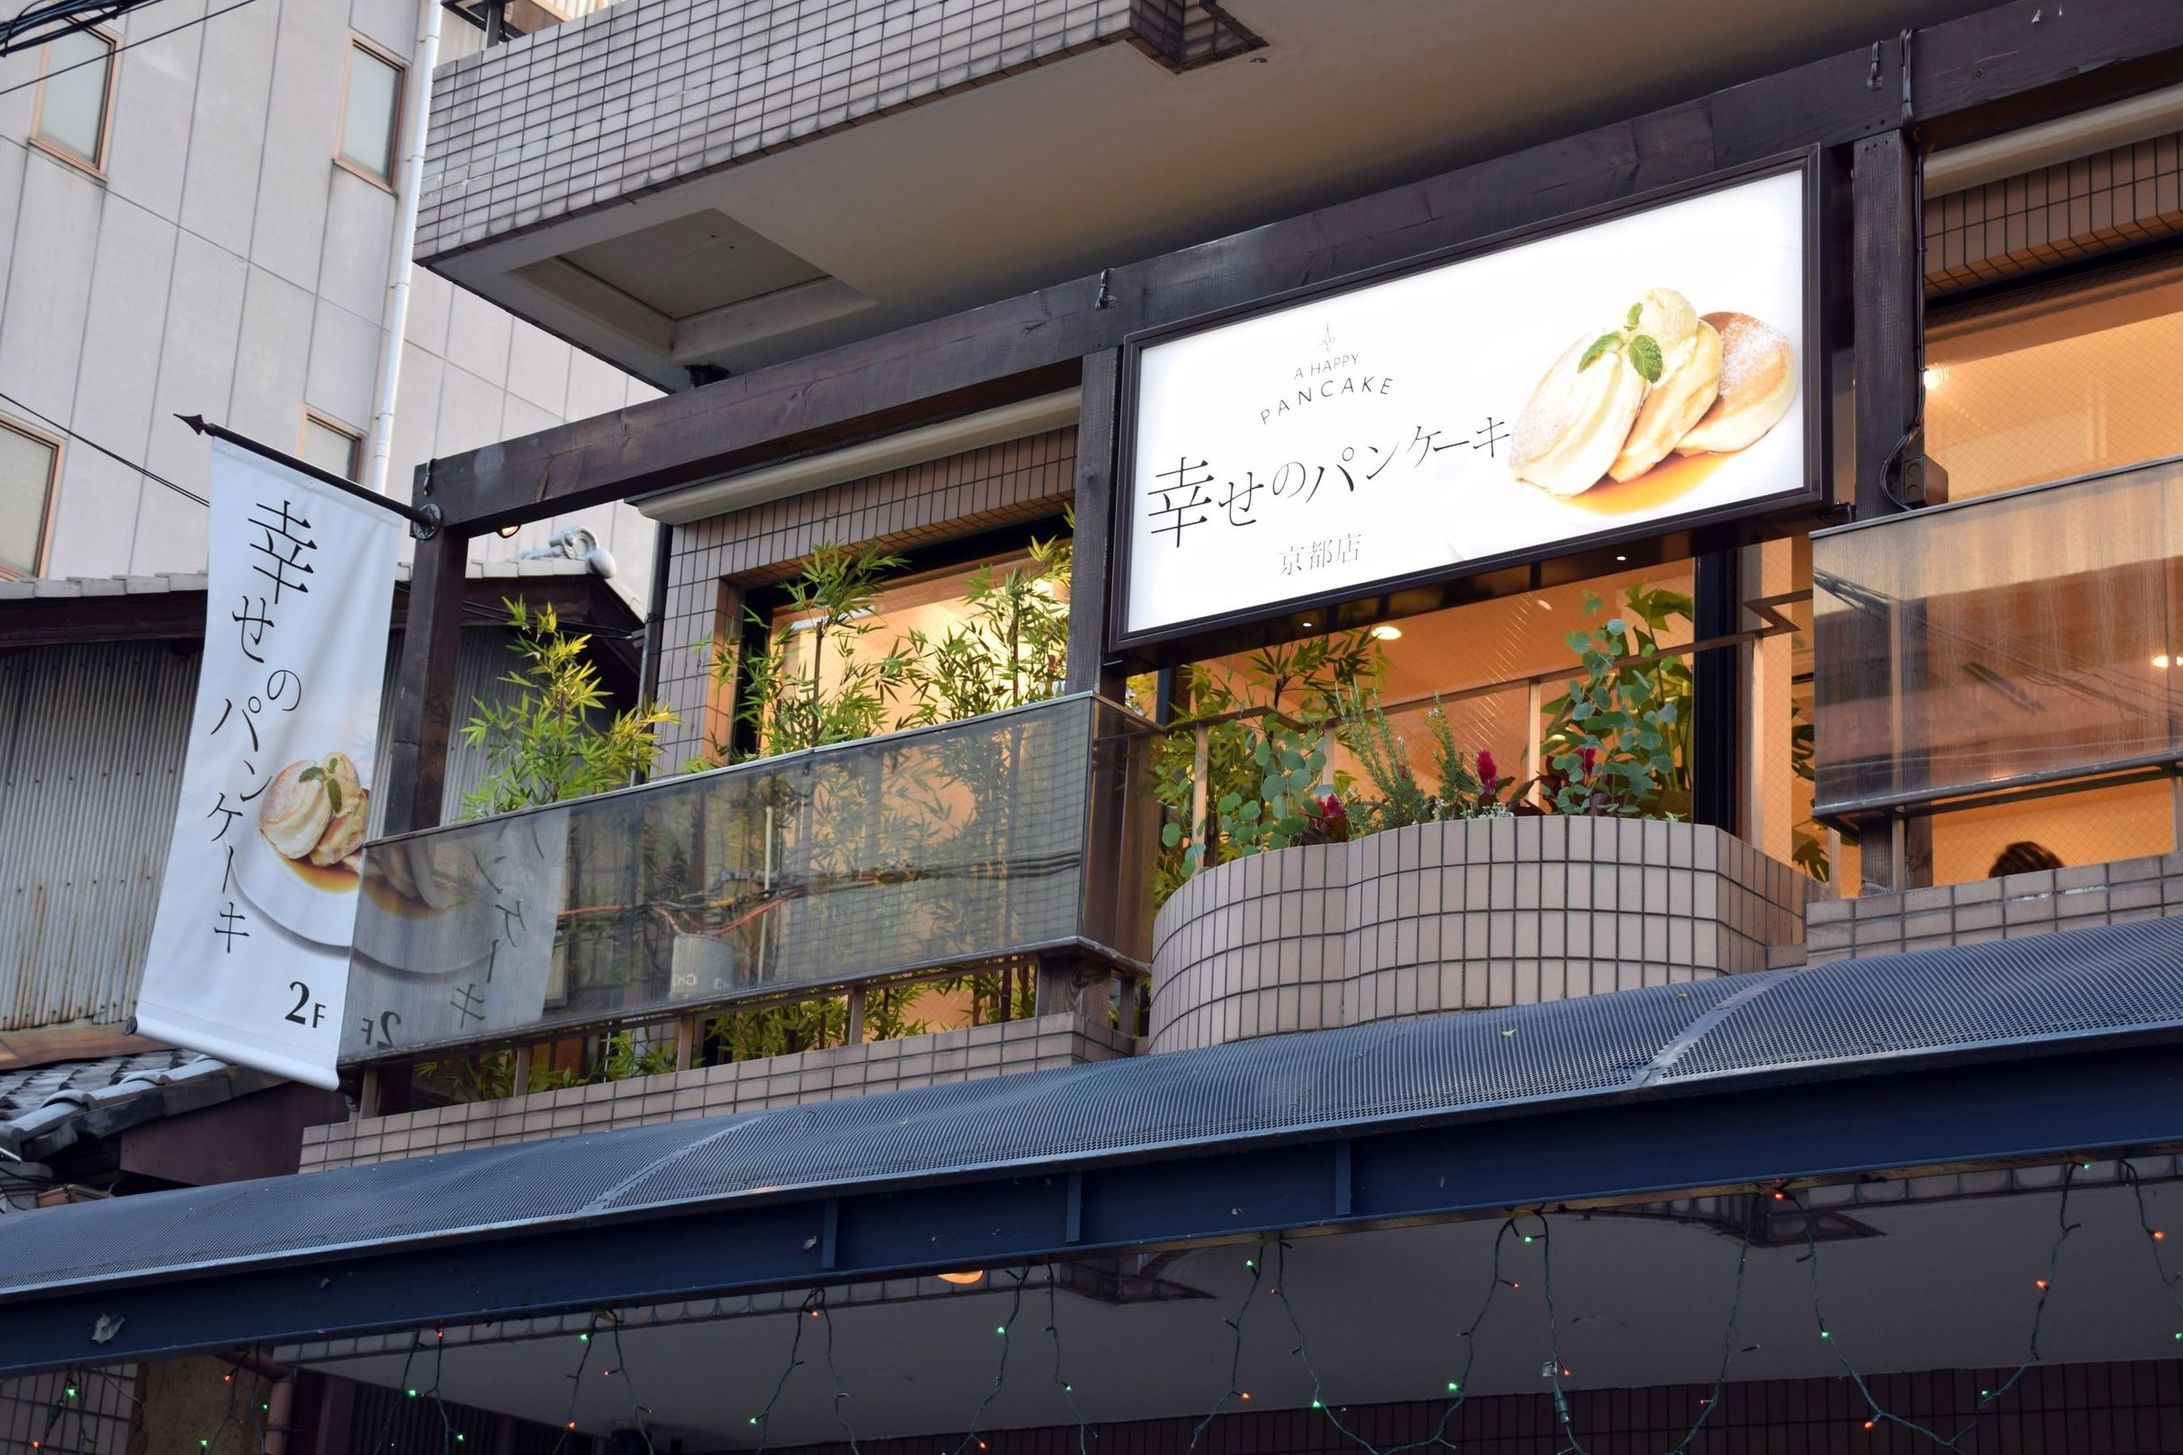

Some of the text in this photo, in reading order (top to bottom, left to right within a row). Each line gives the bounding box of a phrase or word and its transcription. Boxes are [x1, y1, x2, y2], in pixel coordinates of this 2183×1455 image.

[1294, 352, 1360, 380] A HAPPY
[1260, 376, 1394, 425] PANCAKE
[1147, 416, 1511, 549] 幸せのパンケーキ
[1278, 532, 1363, 577] 京都店
[207, 499, 318, 954] 幸せのパンケーキ
[284, 980, 327, 1029] 2F
